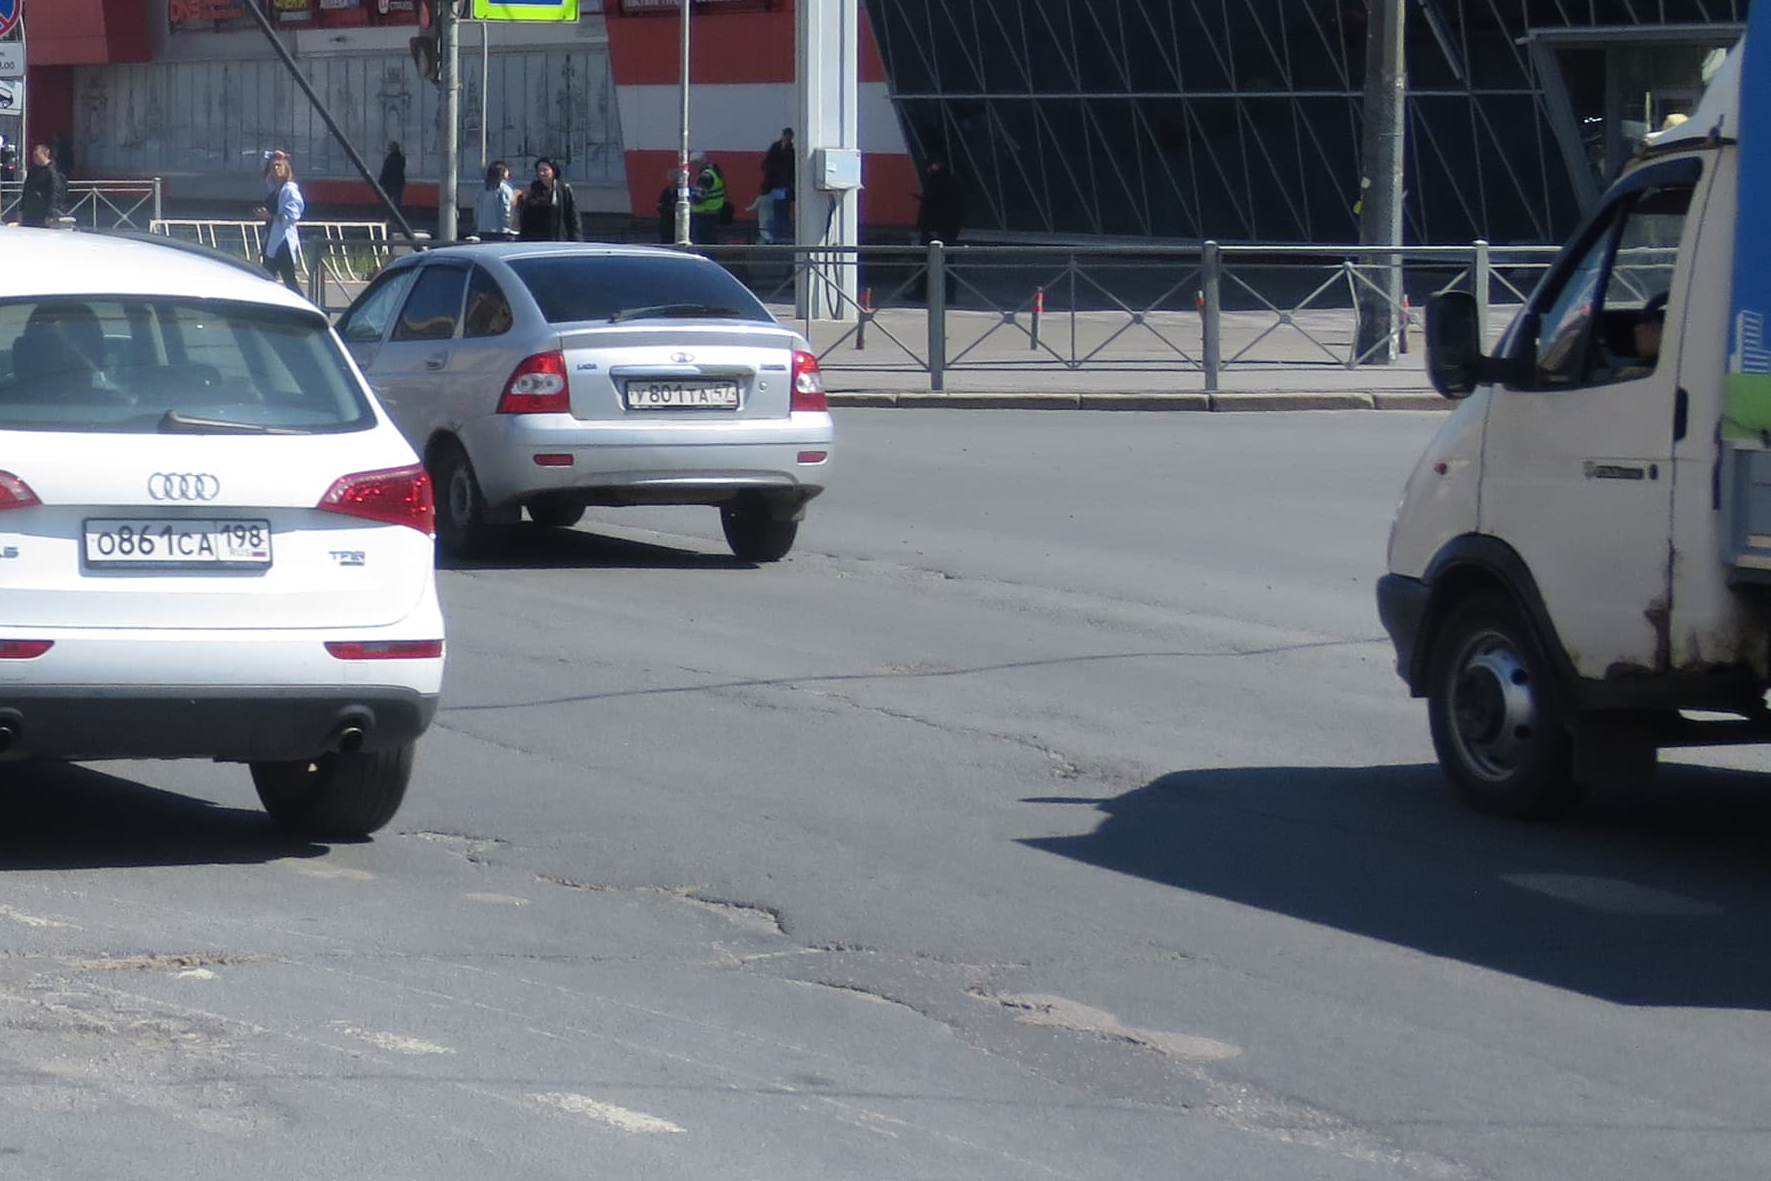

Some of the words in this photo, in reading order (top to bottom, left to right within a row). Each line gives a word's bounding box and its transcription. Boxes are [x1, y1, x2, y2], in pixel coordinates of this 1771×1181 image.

[636, 385, 709, 403] У801ТА
[96, 525, 214, 556] О861СА
[219, 523, 265, 549] 198
